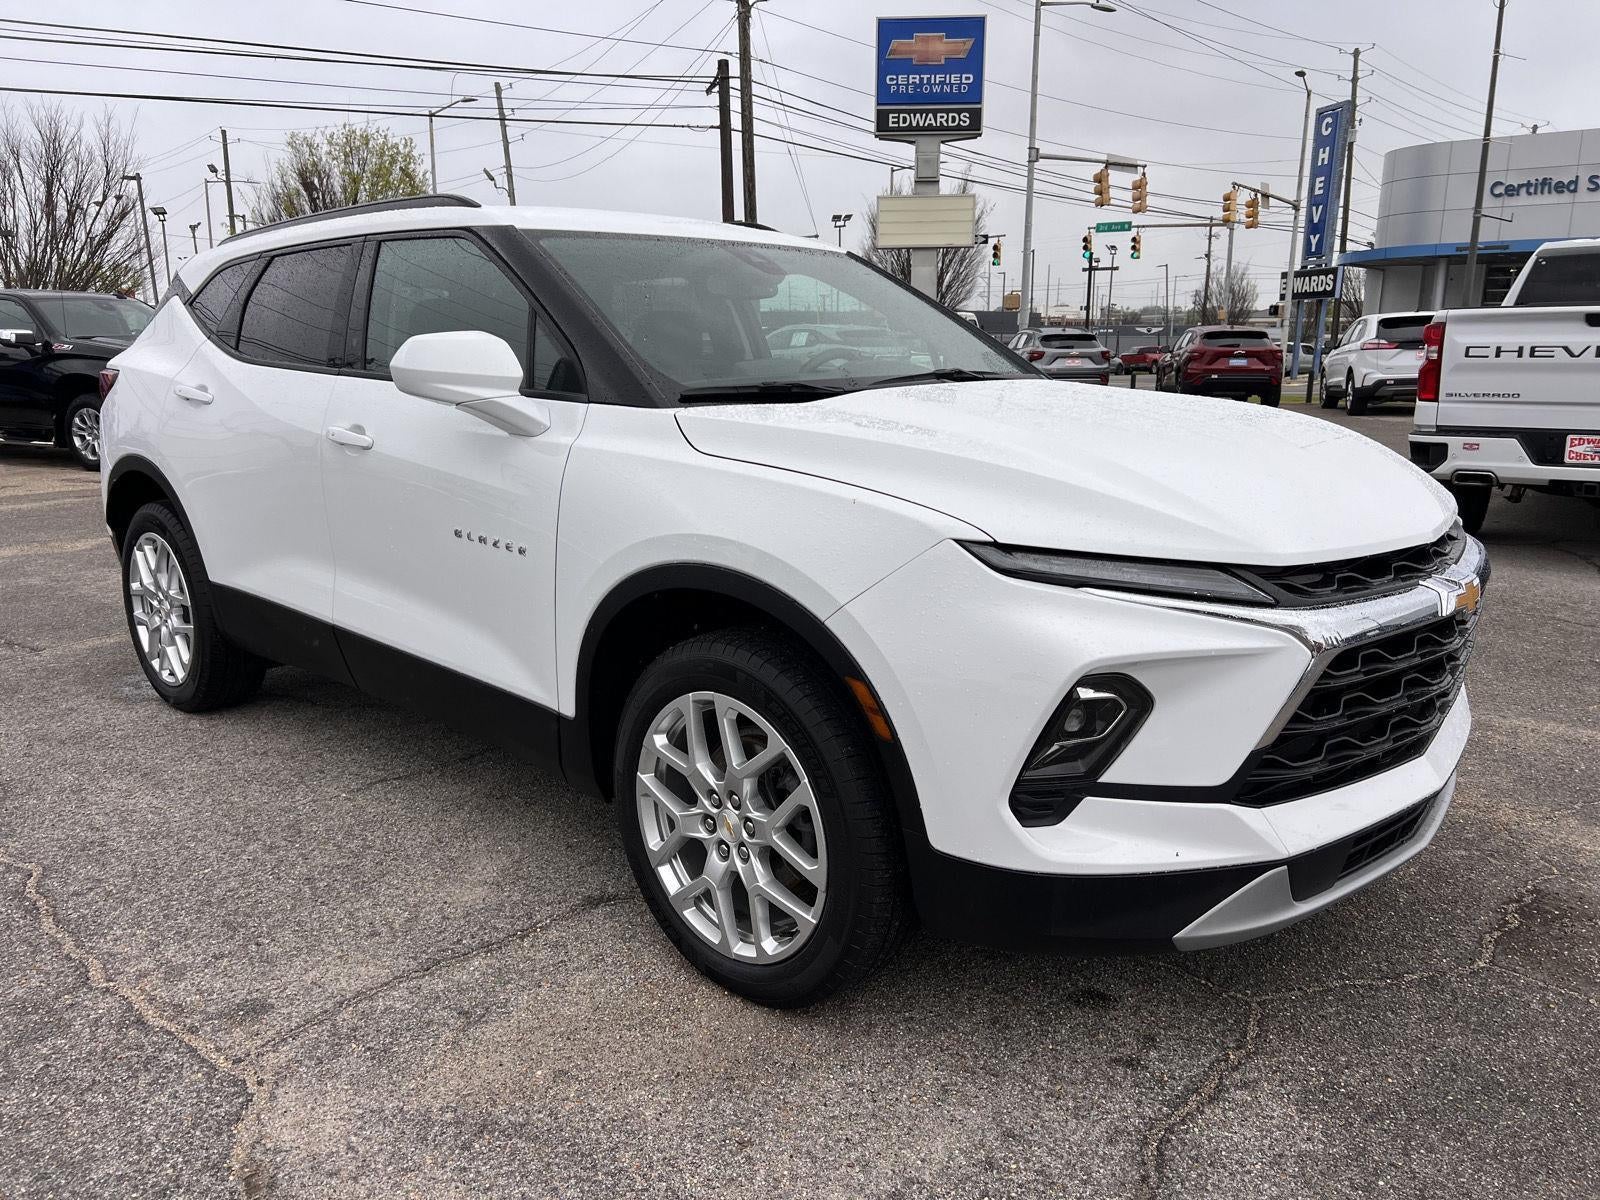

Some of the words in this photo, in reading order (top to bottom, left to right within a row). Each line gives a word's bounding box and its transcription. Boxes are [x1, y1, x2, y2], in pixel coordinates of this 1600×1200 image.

[886, 74, 973, 84] CERTIFIED
[890, 84, 968, 93] PRE-OWNED
[888, 112, 970, 127] EDWARDS
[1309, 117, 1333, 252] CHEVY
[1490, 175, 1579, 197] Certified
[1280, 273, 1334, 294] EWARDS
[1464, 345, 1600, 358] CHEV
[454, 528, 527, 557] BLAZER
